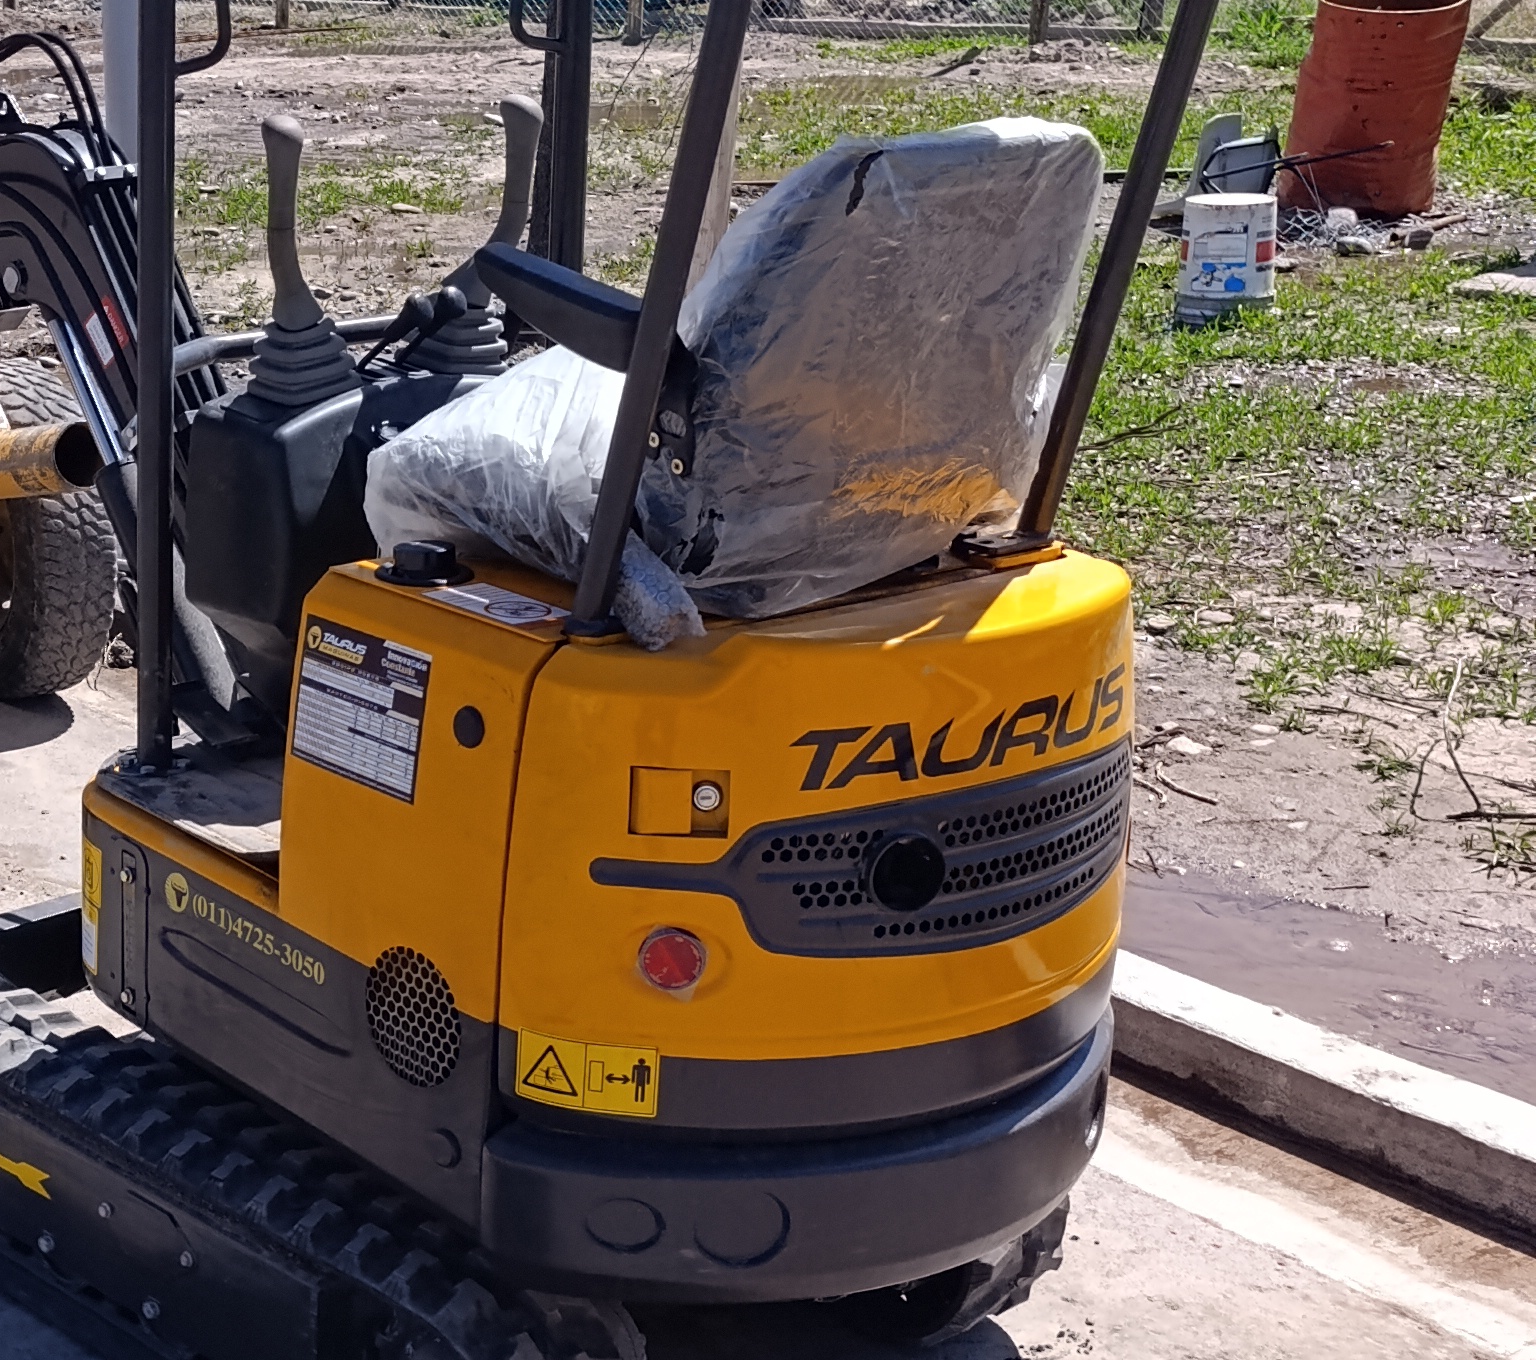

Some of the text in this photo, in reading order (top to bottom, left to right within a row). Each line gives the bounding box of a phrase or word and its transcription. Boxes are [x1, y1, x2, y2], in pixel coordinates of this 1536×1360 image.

[323, 632, 368, 655] TAURUS
[789, 661, 1126, 792] TAURUS
[192, 893, 325, 985] (011)4725-3050
